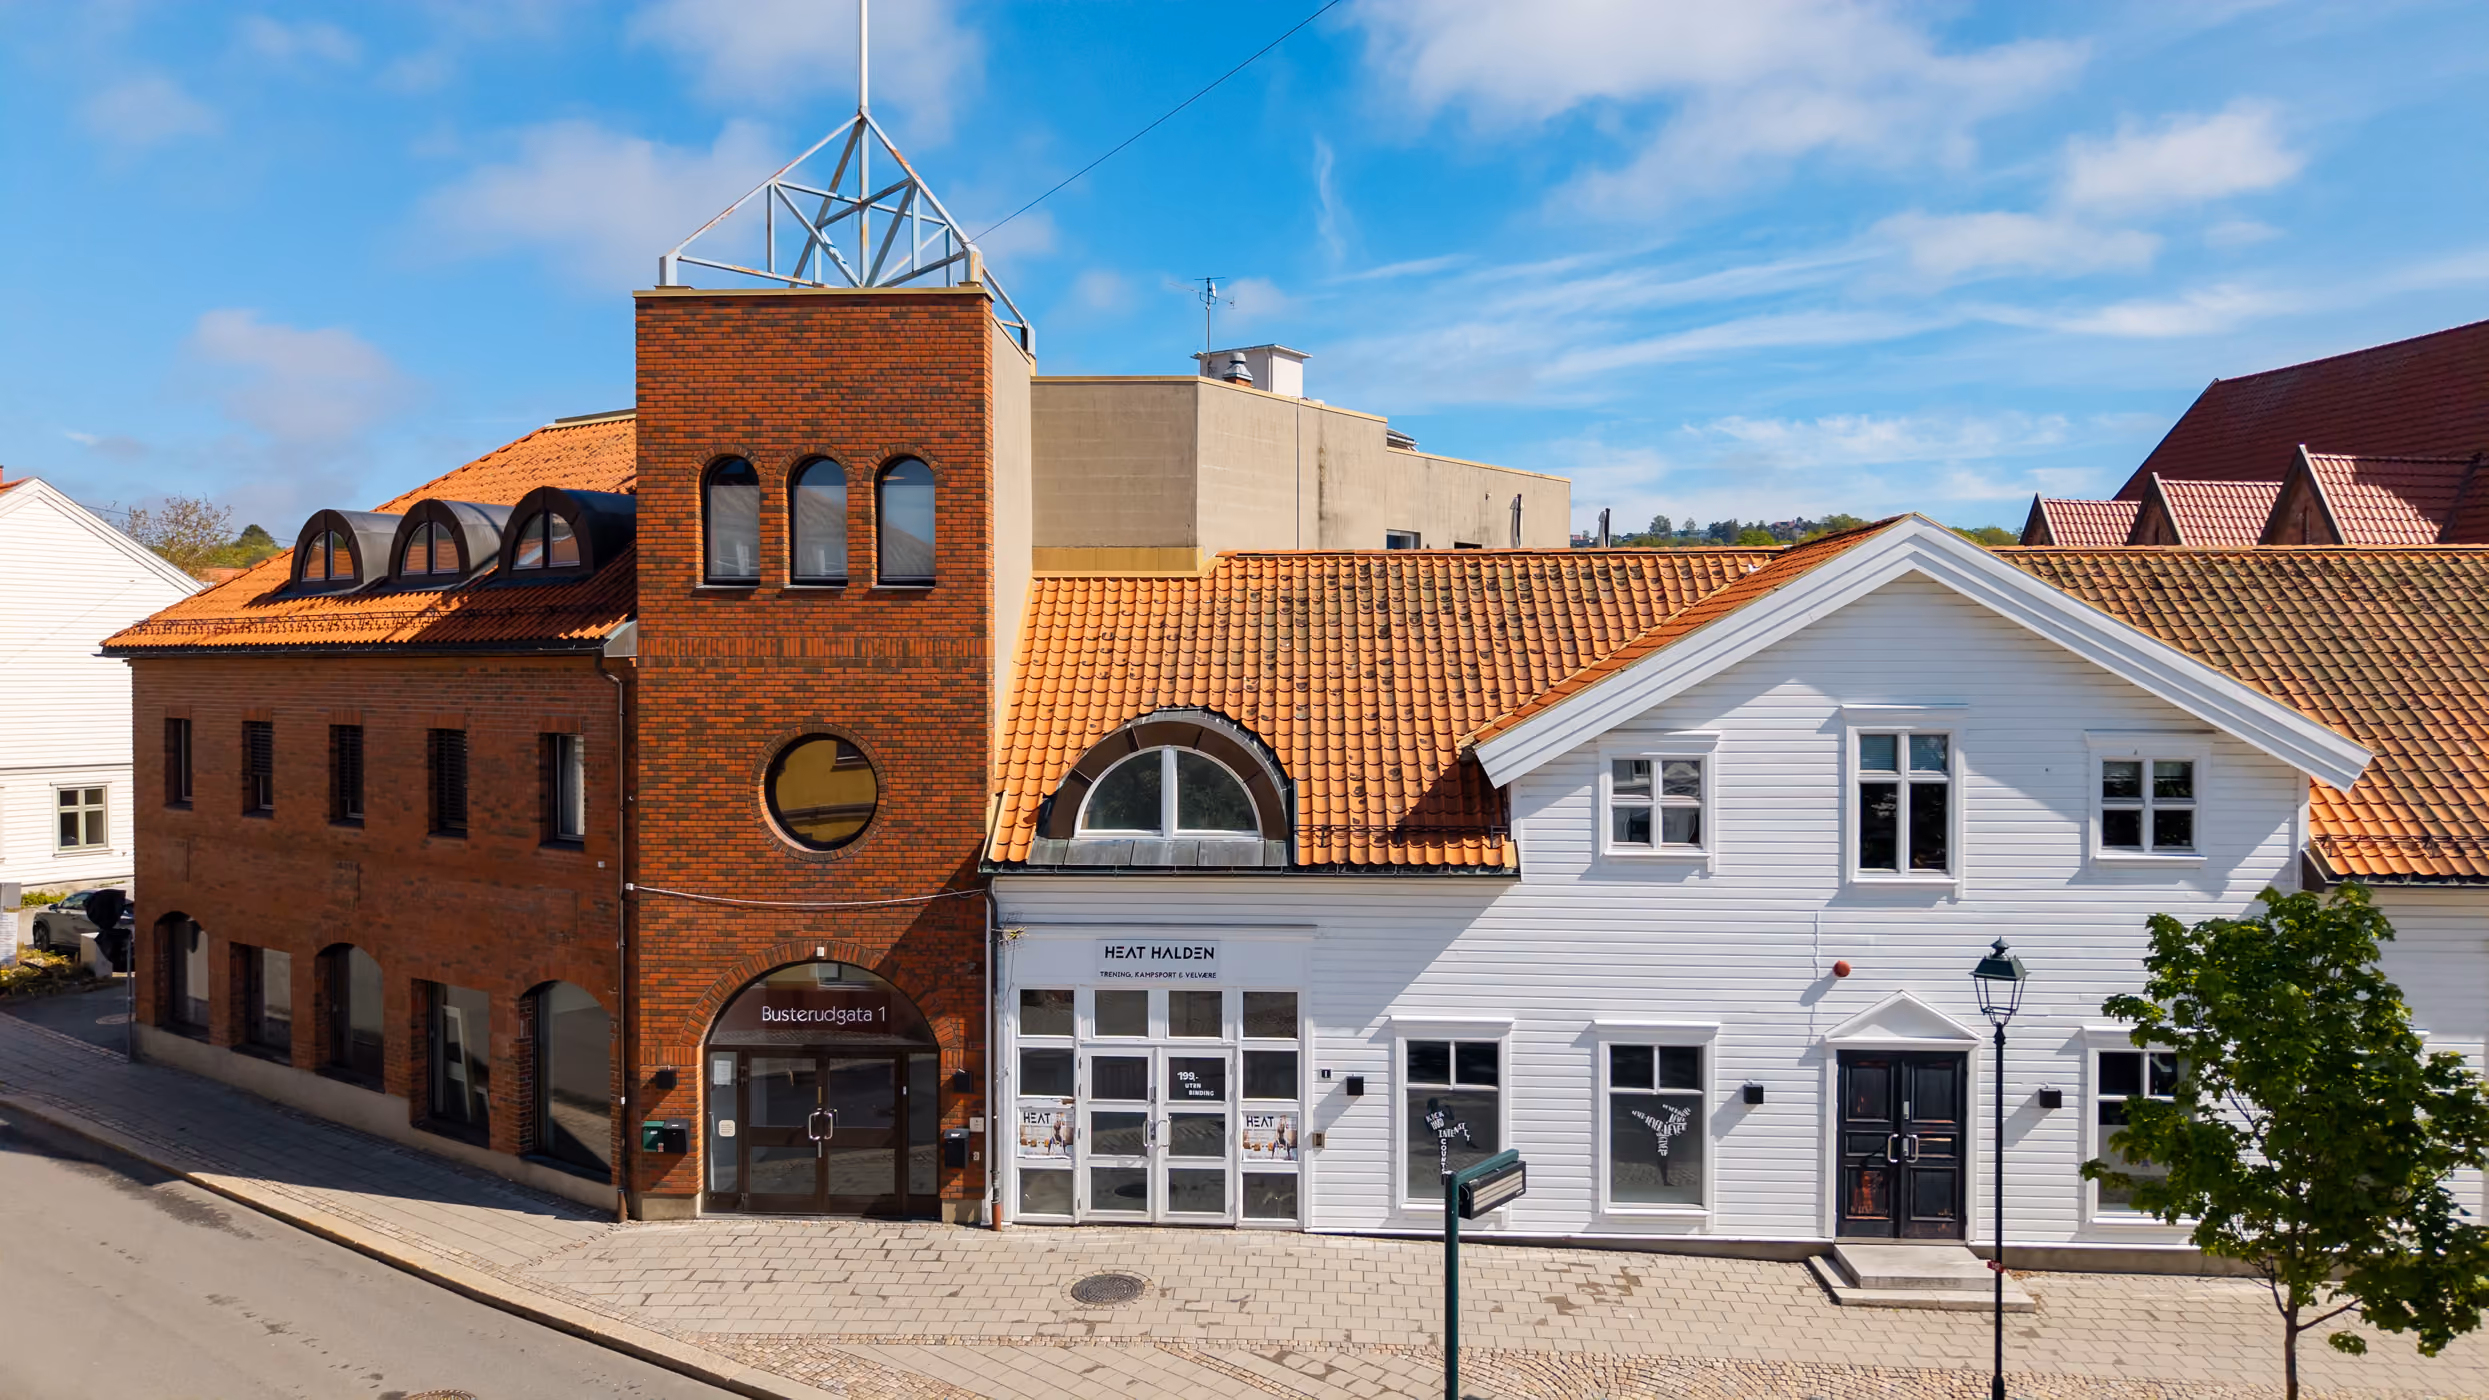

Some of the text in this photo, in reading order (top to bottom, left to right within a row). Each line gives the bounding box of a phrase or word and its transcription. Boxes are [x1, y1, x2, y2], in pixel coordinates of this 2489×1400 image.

[1105, 946, 1215, 960] HEAT HALDEN
[762, 1005, 885, 1025] Busterudgata 1
[1023, 1111, 1051, 1124] HEAT
[1246, 1115, 1274, 1128] HEAT
